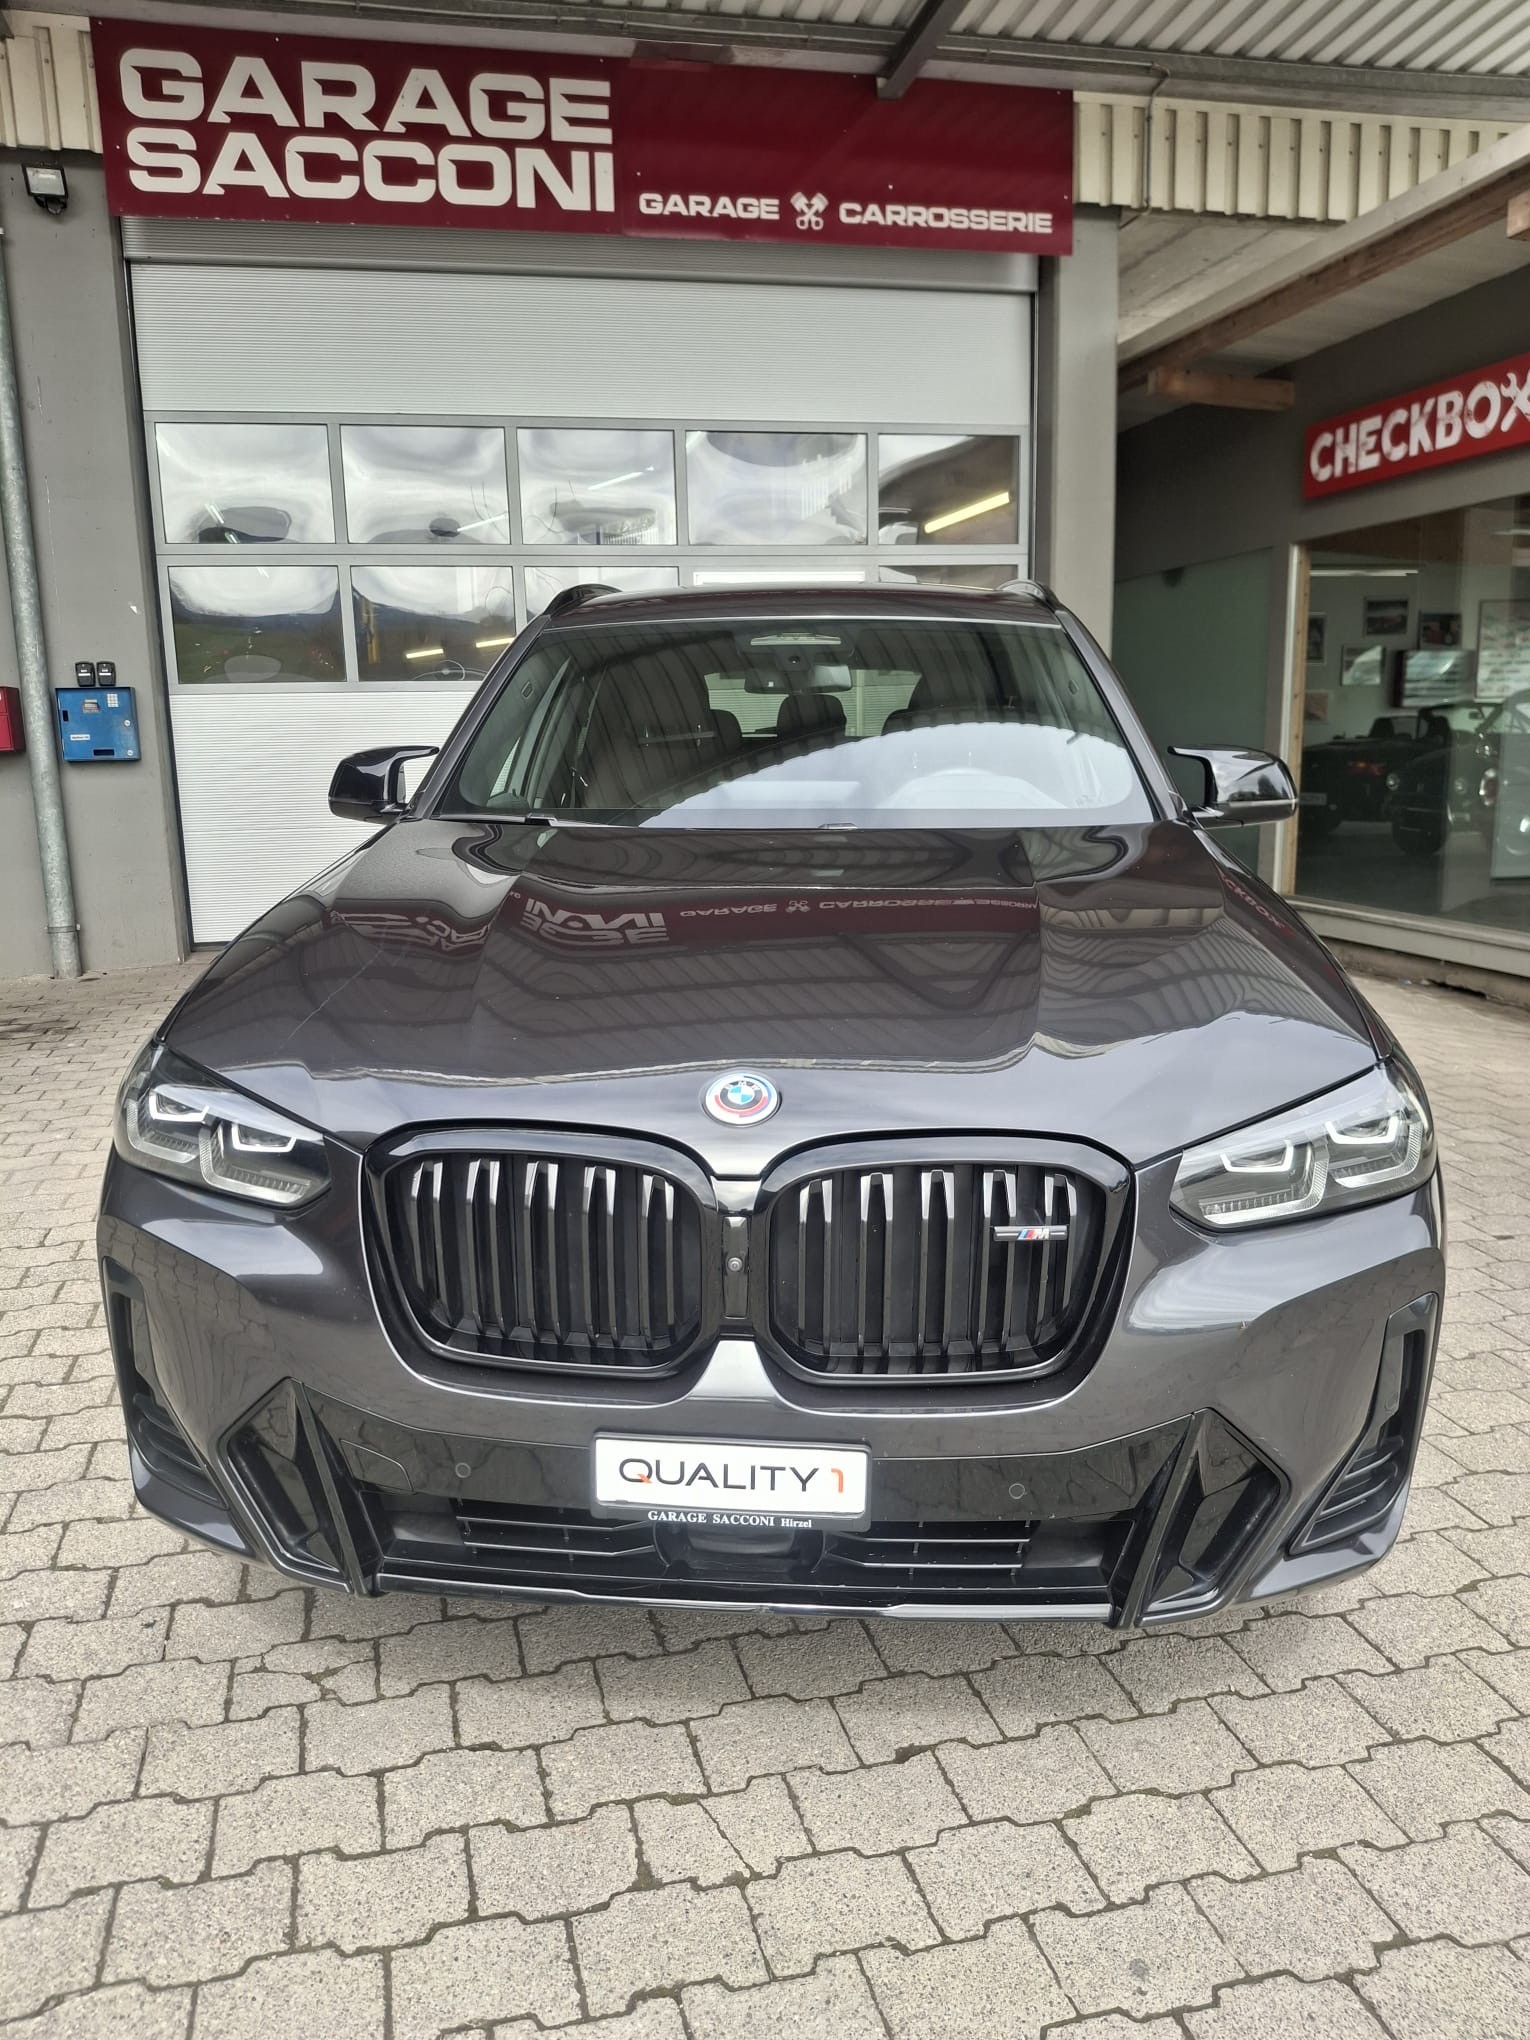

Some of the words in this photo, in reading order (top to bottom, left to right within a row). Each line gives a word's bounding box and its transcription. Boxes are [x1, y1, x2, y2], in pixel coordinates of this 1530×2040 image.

[119, 47, 613, 145] GARAGE
[126, 126, 616, 212] SACCONI
[638, 192, 780, 221] GARAGE
[838, 201, 1053, 234] CARROSSERIE
[618, 1457, 820, 1492] QUALITY
[831, 1467, 844, 1493] 1
[647, 1510, 708, 1524] GARAGE
[712, 1513, 776, 1527] SACCONI
[780, 1518, 812, 1529] Hirzel
